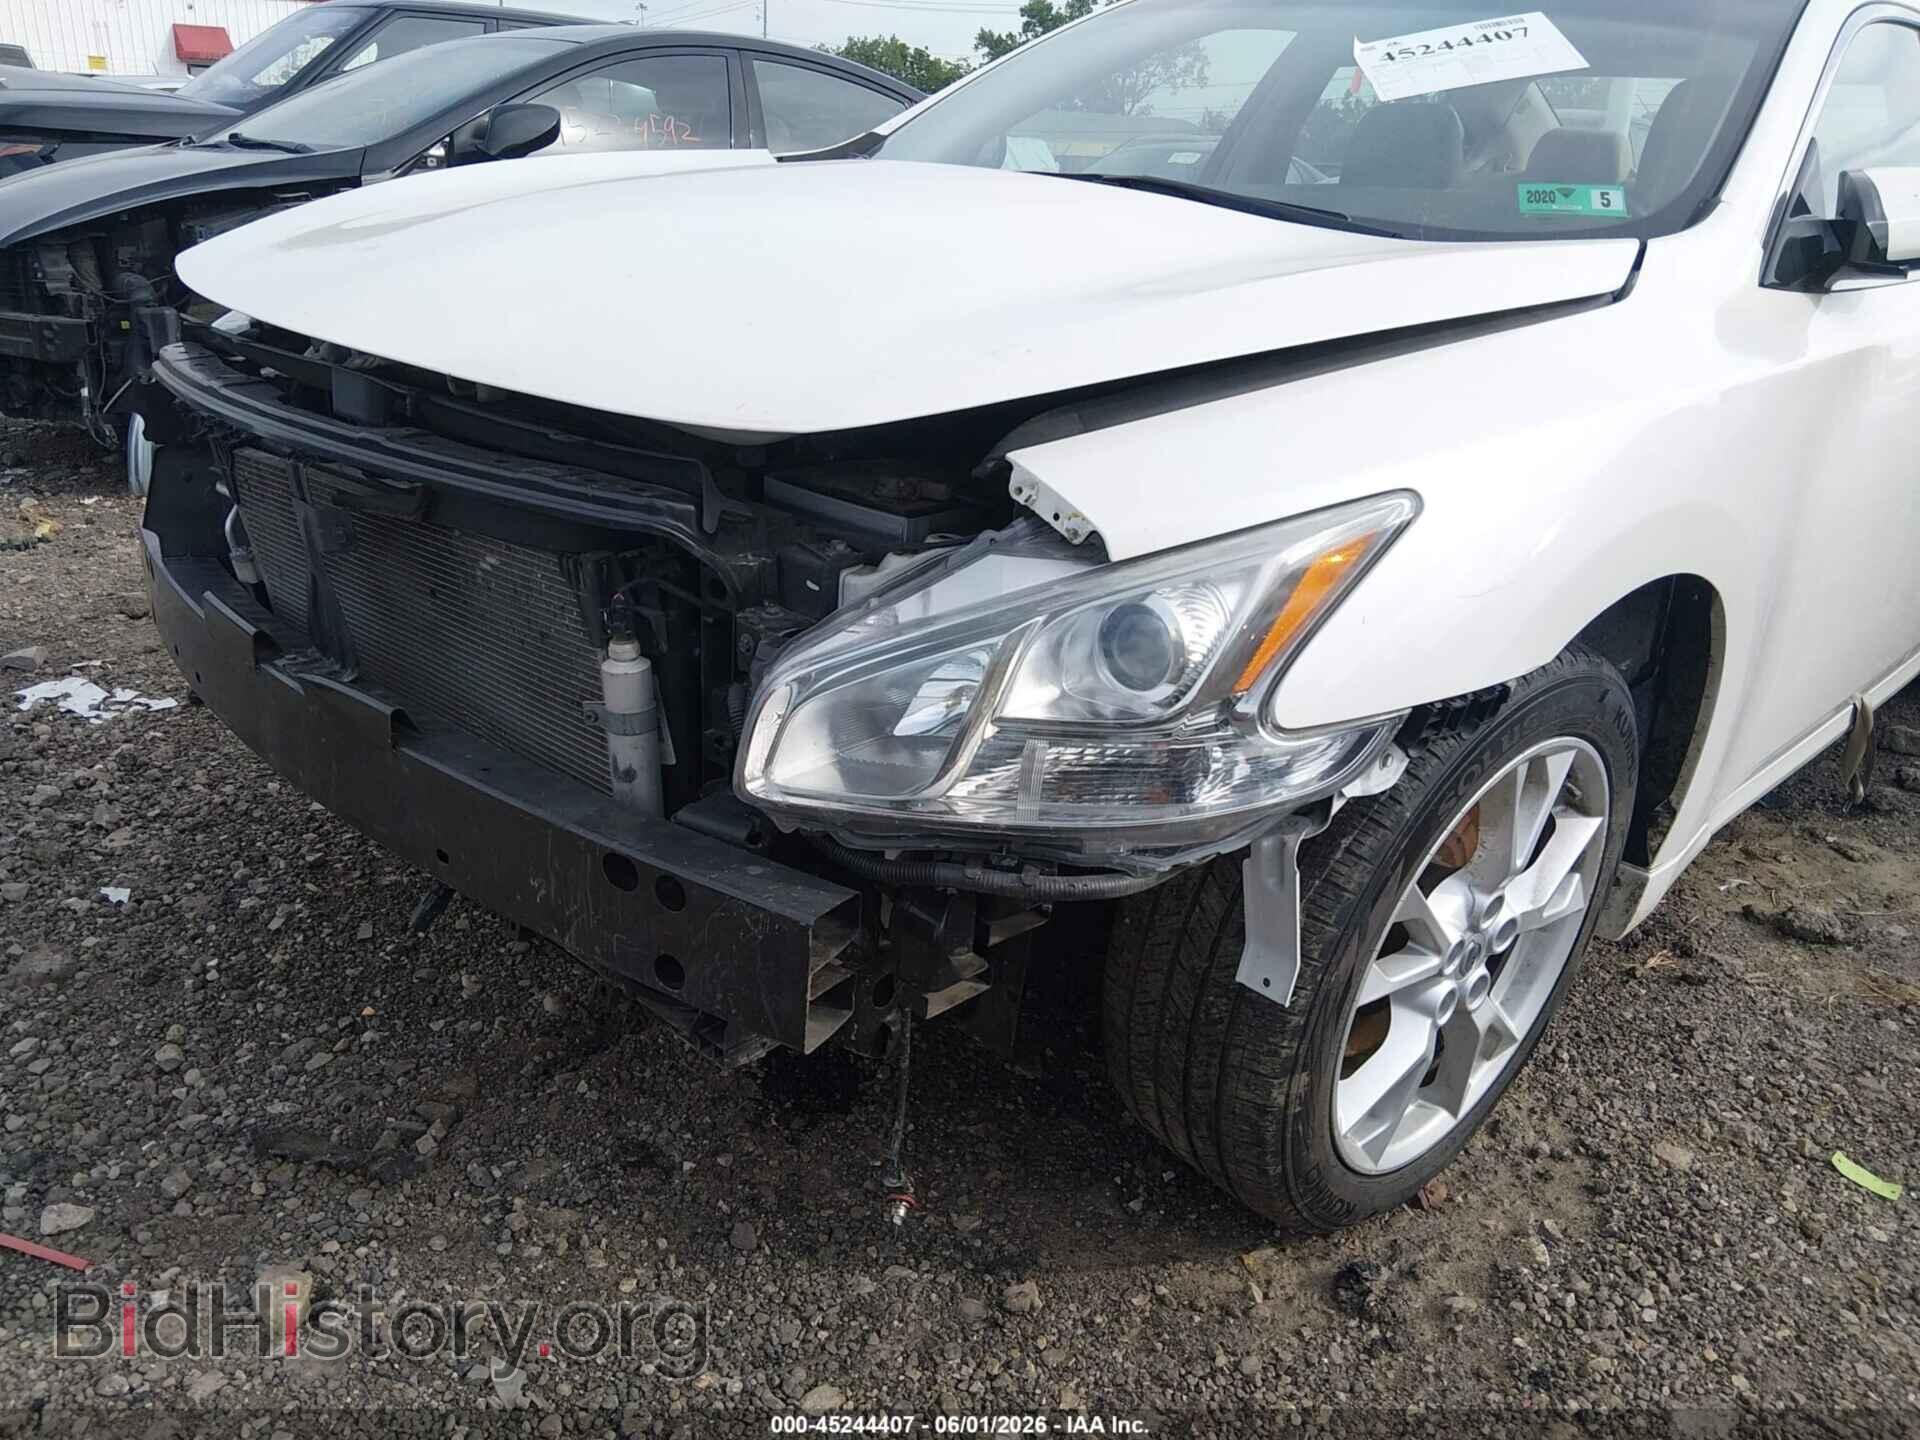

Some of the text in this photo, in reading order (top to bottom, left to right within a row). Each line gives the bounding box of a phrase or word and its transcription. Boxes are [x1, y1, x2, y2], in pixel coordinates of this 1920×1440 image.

[1380, 26, 1529, 62] 45244407
[1526, 190, 1556, 204] 2020
[1600, 192, 1611, 208] 5
